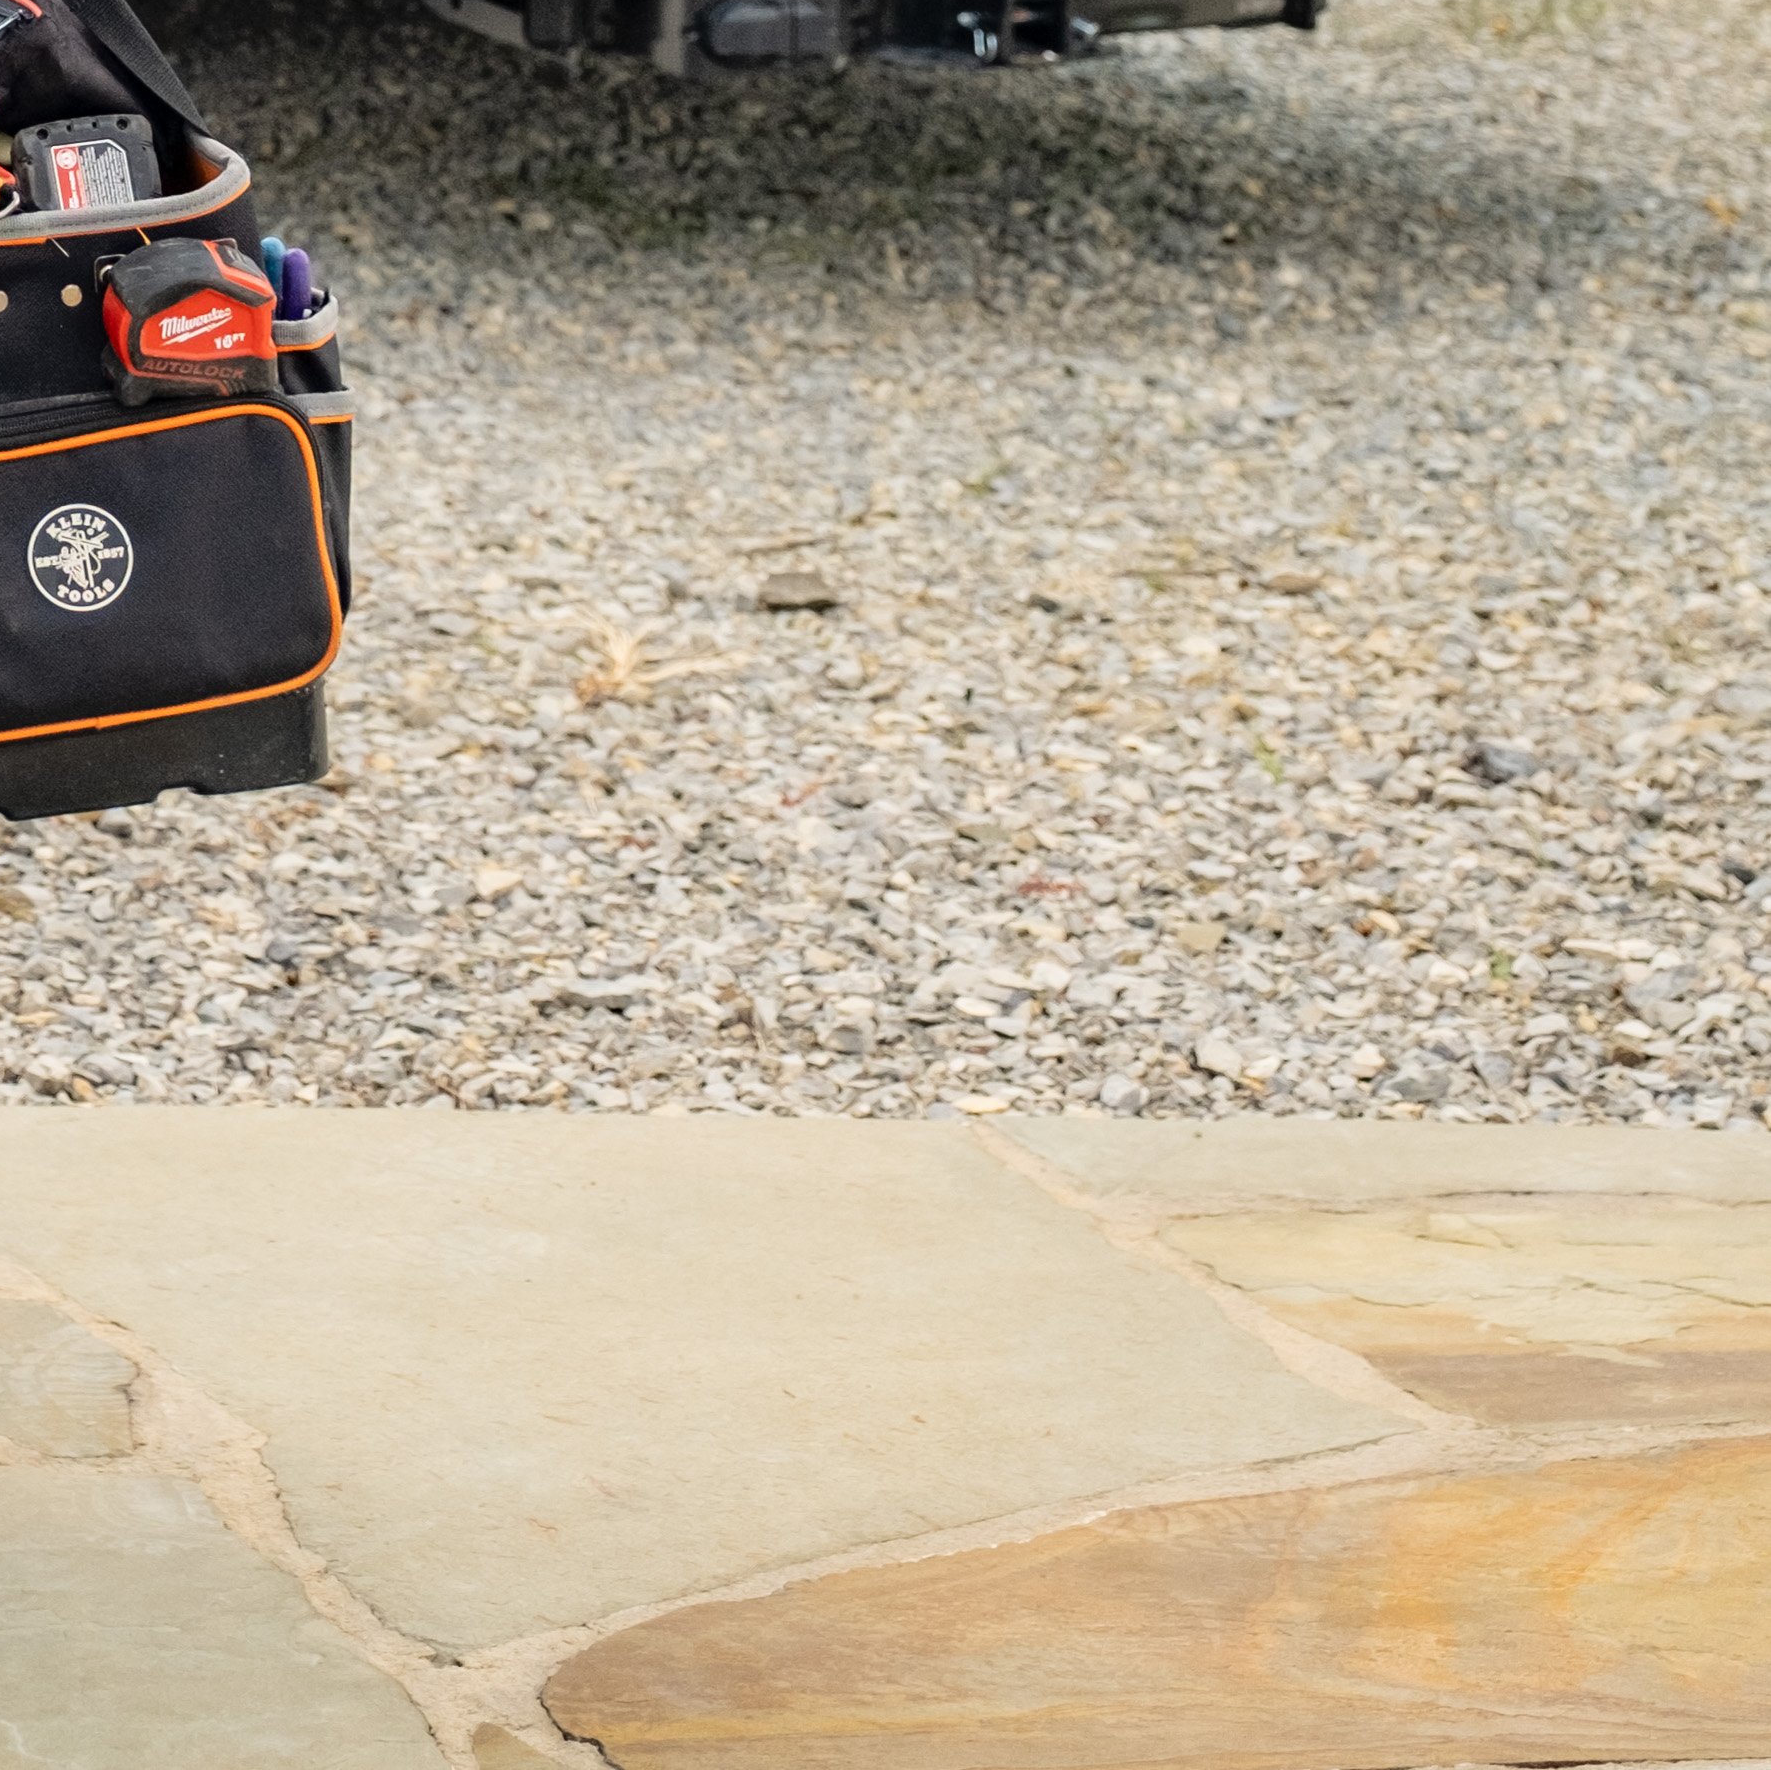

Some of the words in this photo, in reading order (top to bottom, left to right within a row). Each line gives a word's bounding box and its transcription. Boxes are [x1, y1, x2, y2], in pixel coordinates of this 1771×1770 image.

[142, 359, 247, 379] AUTOLOCK
[46, 513, 106, 539] KLEIN
[57, 578, 115, 603] TOOLS
